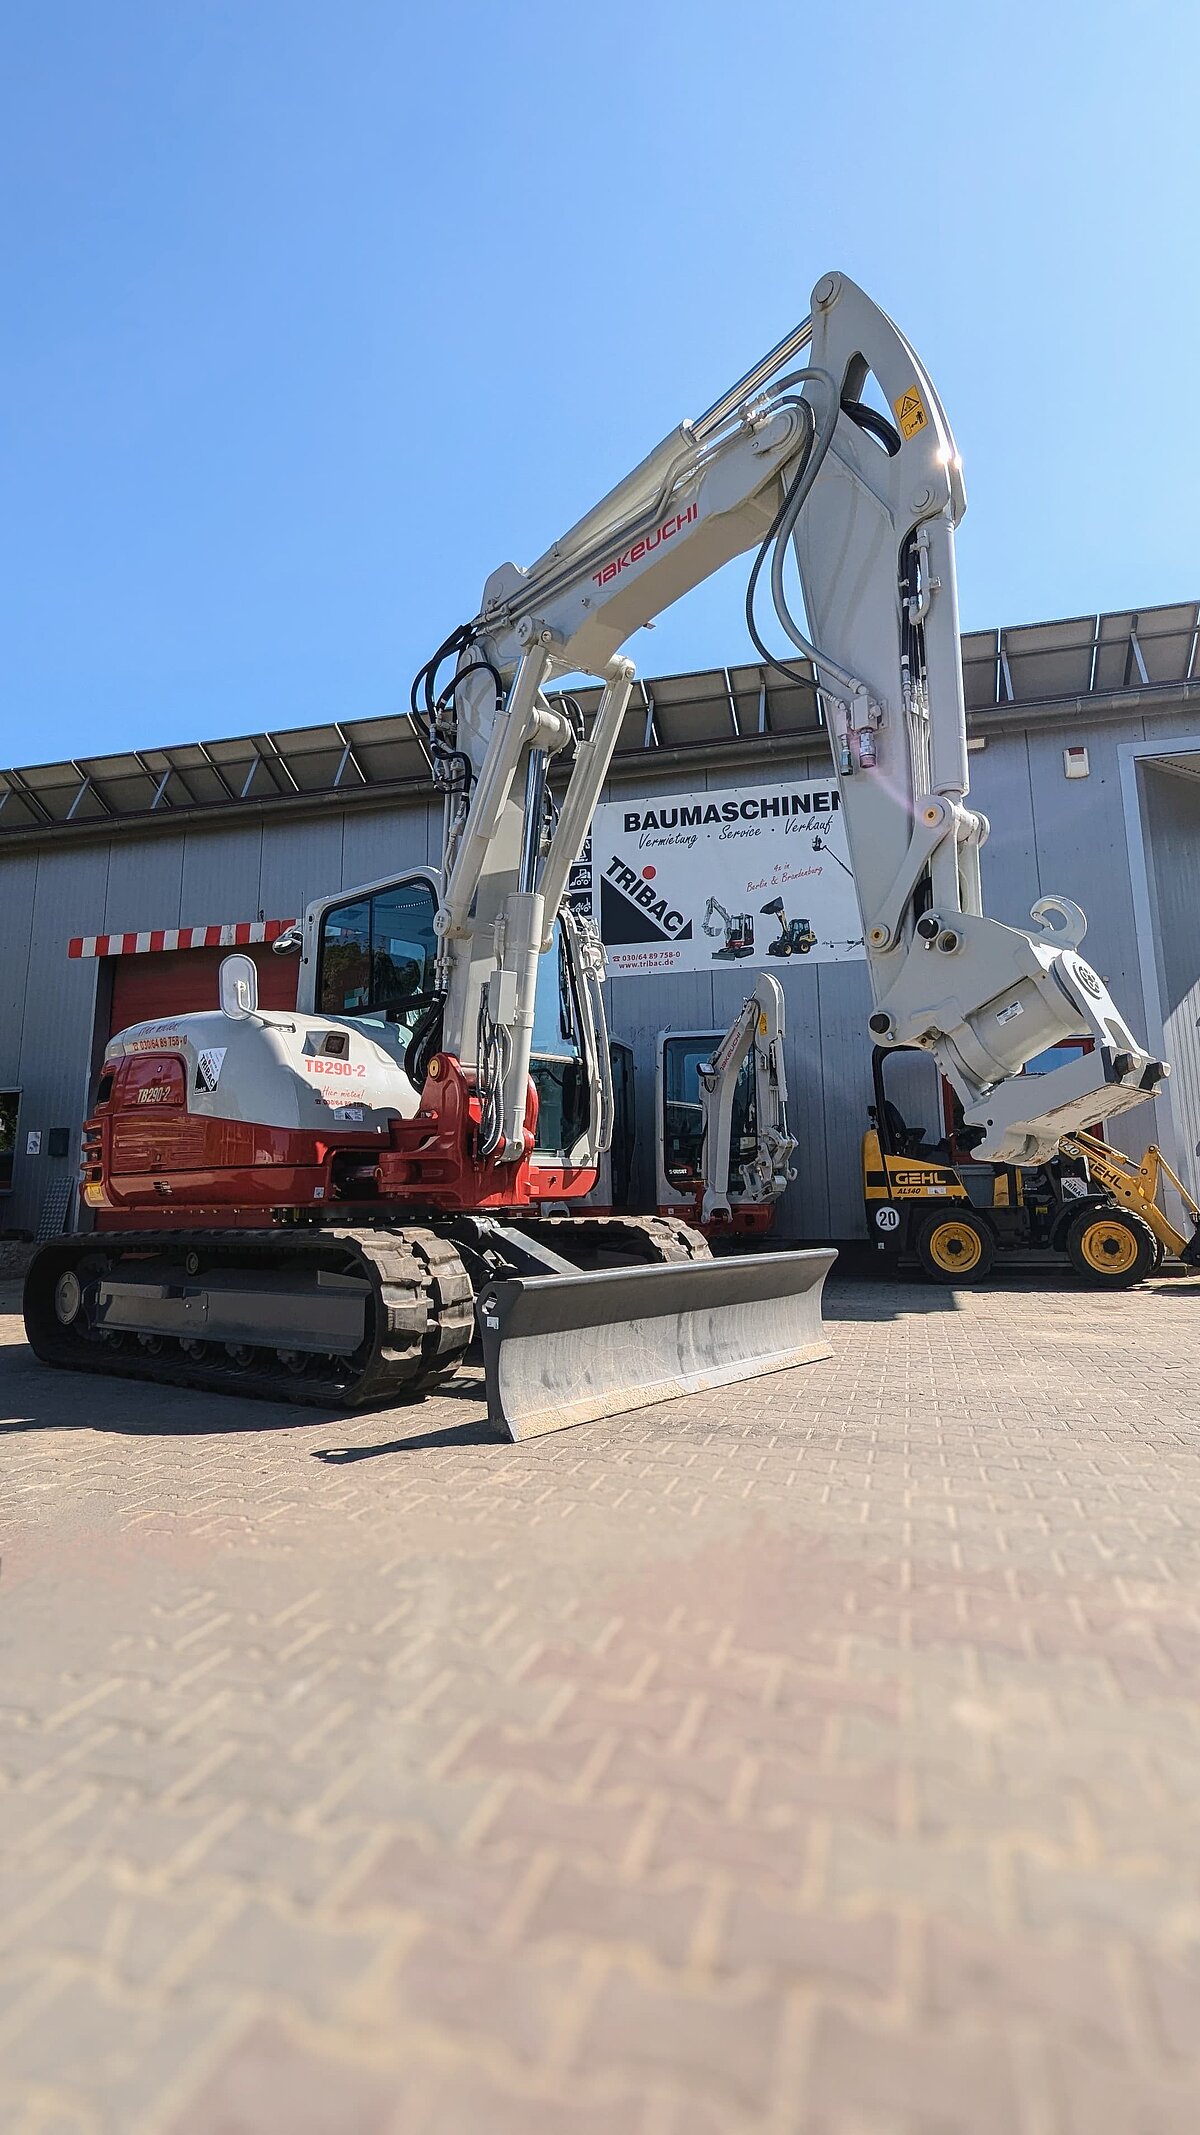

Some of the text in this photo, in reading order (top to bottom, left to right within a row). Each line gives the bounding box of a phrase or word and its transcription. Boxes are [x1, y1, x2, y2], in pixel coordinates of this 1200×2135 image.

[592, 502, 698, 588] TAKEUCHI
[638, 814, 834, 850] Vermietung Service Verkauf
[746, 878, 768, 893] Berlin
[781, 866, 824, 883] Brandenburg
[605, 855, 684, 932] TRIBAC
[618, 959, 674, 969] www.tribac.de
[622, 950, 681, 962] 030/64 89 758-0
[305, 1059, 366, 1077] TB290-2
[138, 1086, 171, 1103] TB290-2
[895, 1172, 946, 1185] GEHL
[897, 1187, 921, 1195] AL140
[879, 1211, 896, 1227] 20
